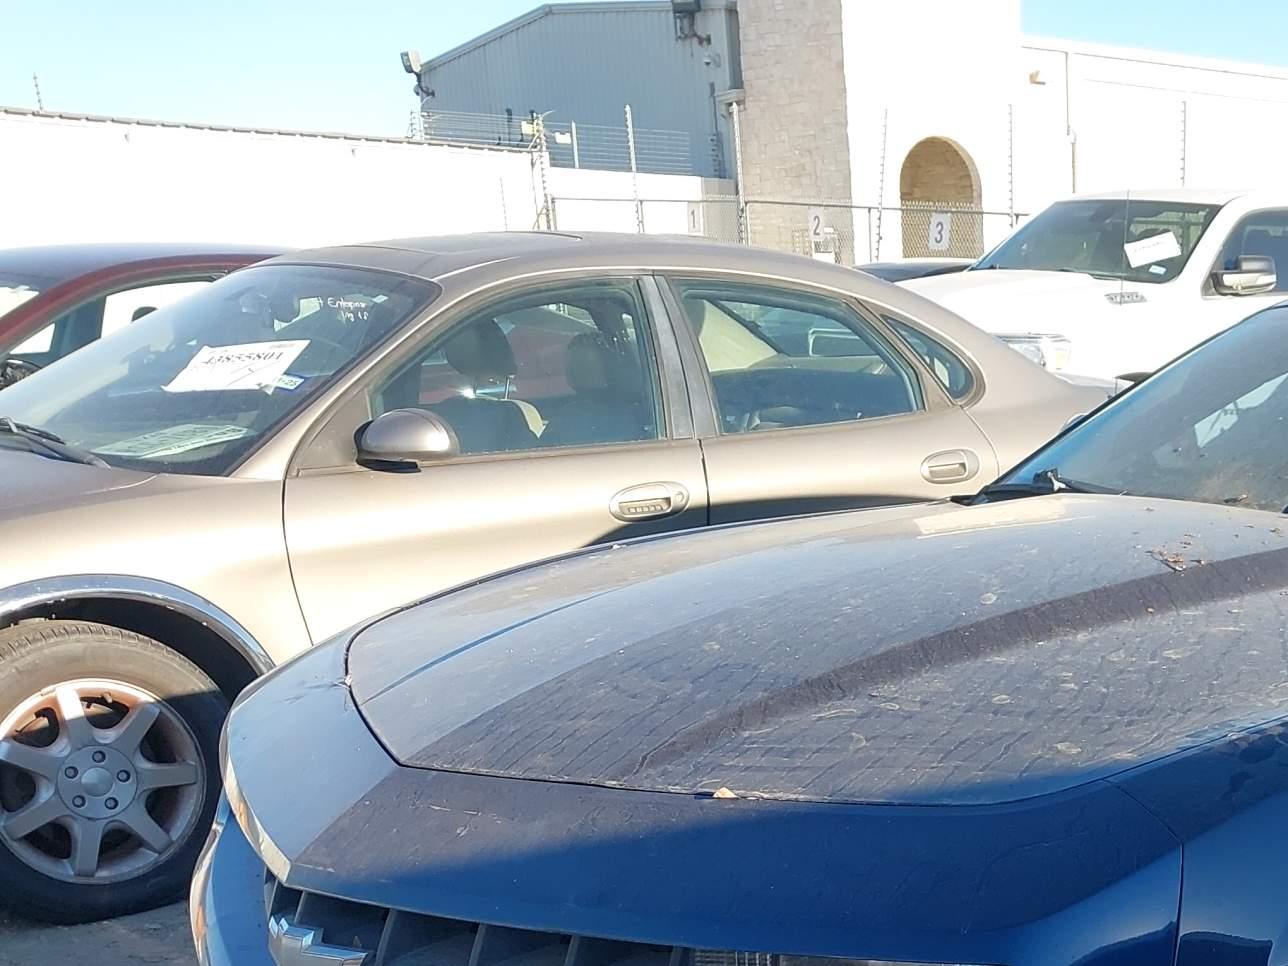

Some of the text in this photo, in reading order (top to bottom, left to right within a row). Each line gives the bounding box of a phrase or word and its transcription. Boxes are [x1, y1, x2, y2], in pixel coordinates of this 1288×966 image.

[690, 209, 697, 229] 1
[813, 215, 821, 236] 2
[934, 221, 944, 244] 3
